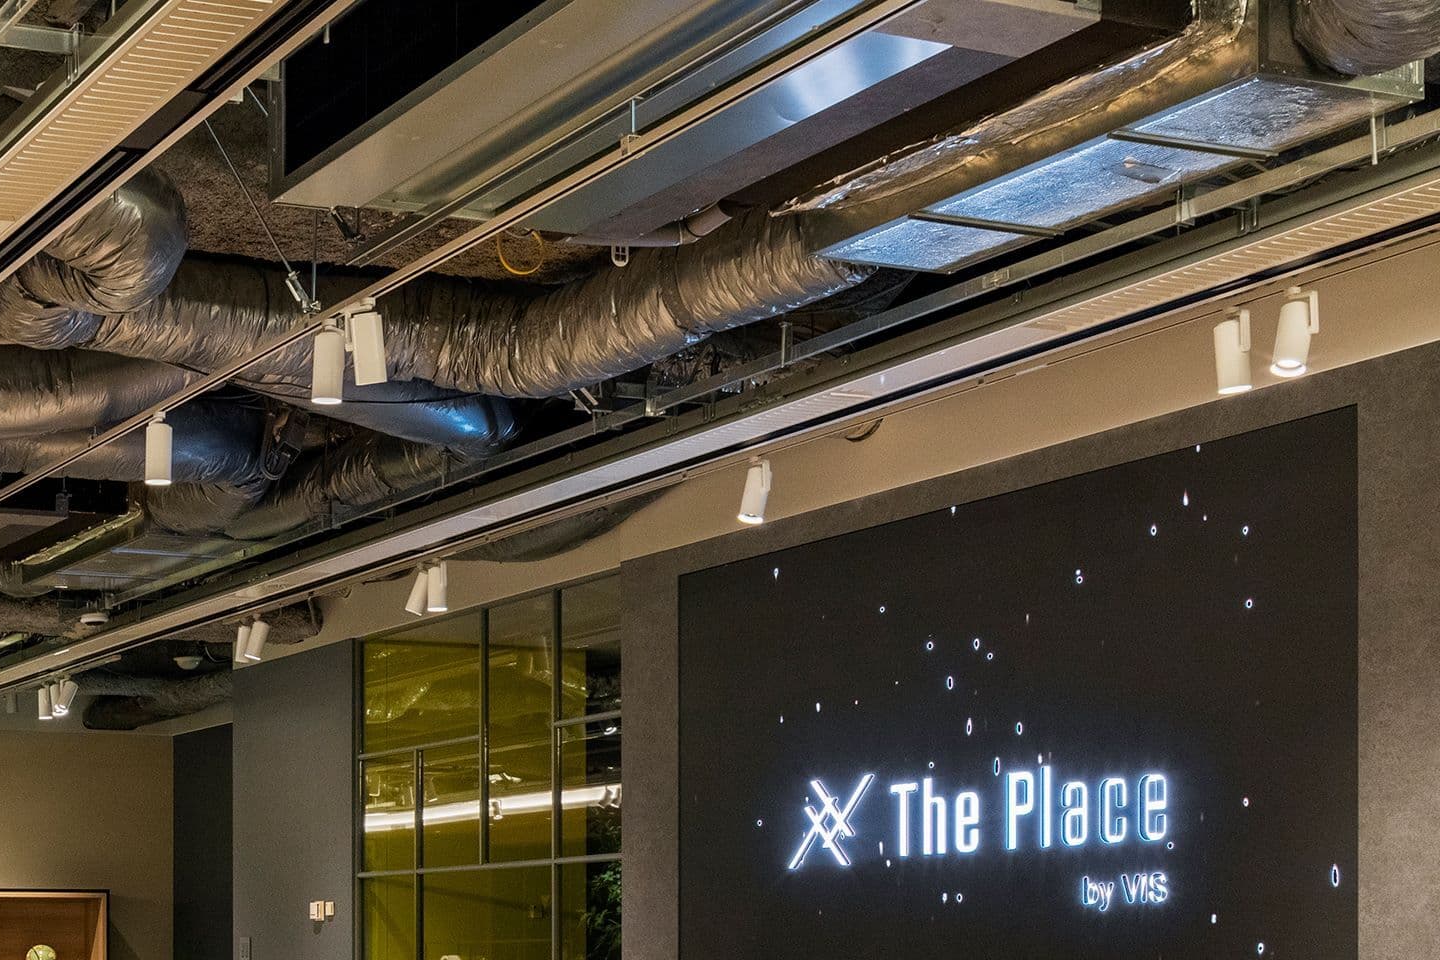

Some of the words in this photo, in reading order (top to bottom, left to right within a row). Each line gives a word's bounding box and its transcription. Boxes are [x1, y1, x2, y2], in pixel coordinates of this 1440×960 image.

[890, 778, 979, 856] The
[1005, 766, 1167, 851] Place
[1082, 876, 1114, 911] by
[1121, 872, 1168, 903] VIS
